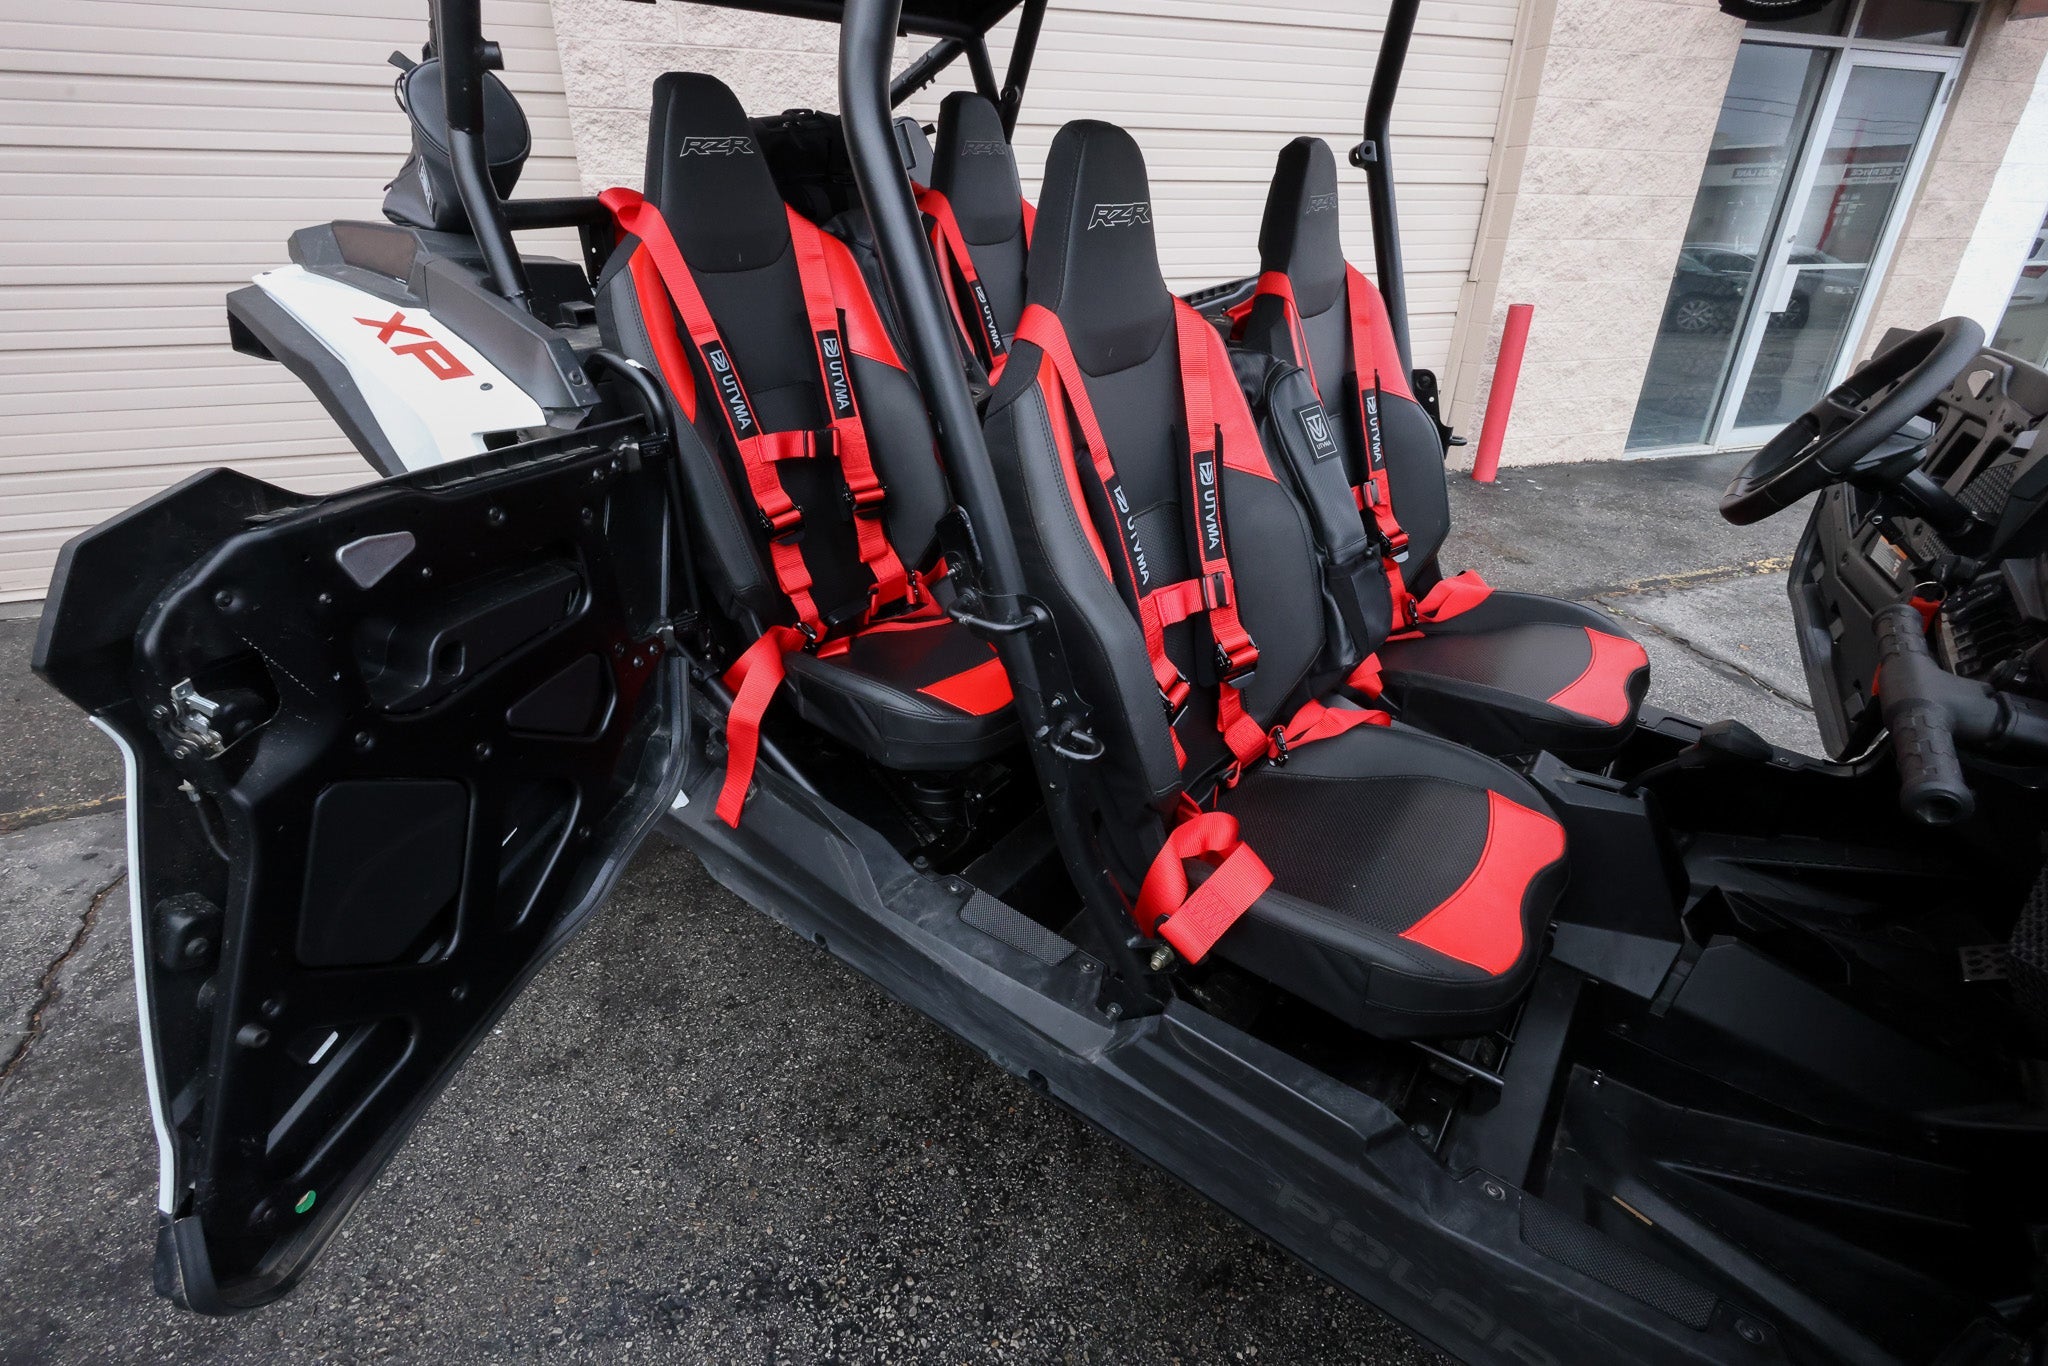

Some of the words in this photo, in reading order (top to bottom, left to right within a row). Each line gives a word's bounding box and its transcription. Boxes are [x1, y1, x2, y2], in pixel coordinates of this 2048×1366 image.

[680, 136, 755, 157] RZR
[961, 140, 1006, 156] RZR
[1087, 201, 1151, 231] RZR
[352, 311, 475, 381] XP
[983, 305, 1001, 349] UTVMA
[722, 374, 753, 431] UTVMA
[829, 360, 850, 411] UTVMA
[1369, 417, 1382, 463] UTVMA
[1204, 489, 1220, 550] UTVMA
